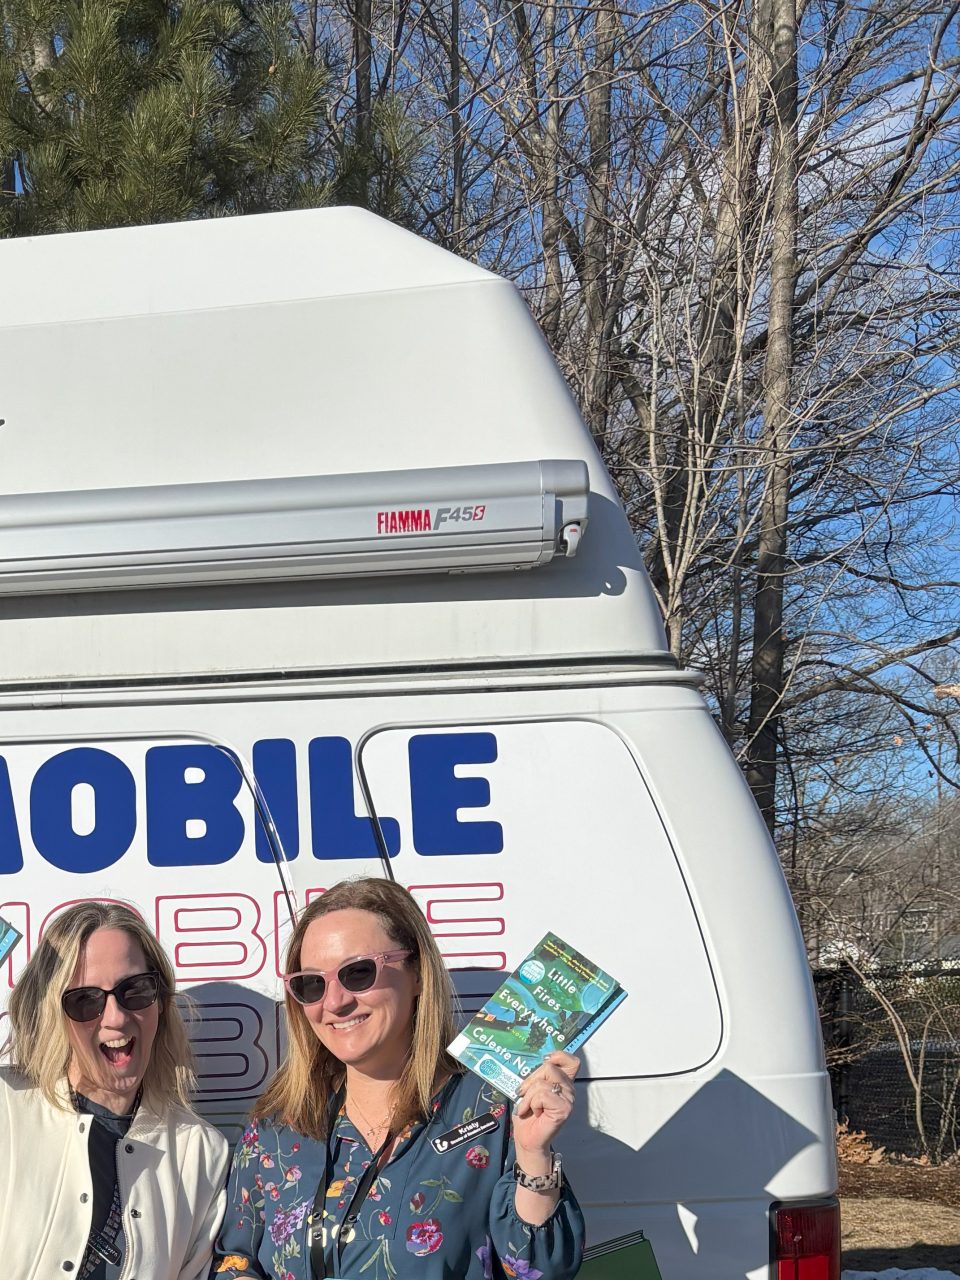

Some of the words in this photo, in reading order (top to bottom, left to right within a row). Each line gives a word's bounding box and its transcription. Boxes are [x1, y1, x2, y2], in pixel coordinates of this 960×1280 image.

[377, 509, 431, 534] FIAMMA
[547, 968, 576, 994] Little
[533, 986, 561, 1011] Fires
[499, 989, 566, 1042] Everywhere
[473, 1027, 512, 1061] Celeste
[513, 1058, 531, 1077] Ng
[458, 1121, 479, 1134] Kristy
